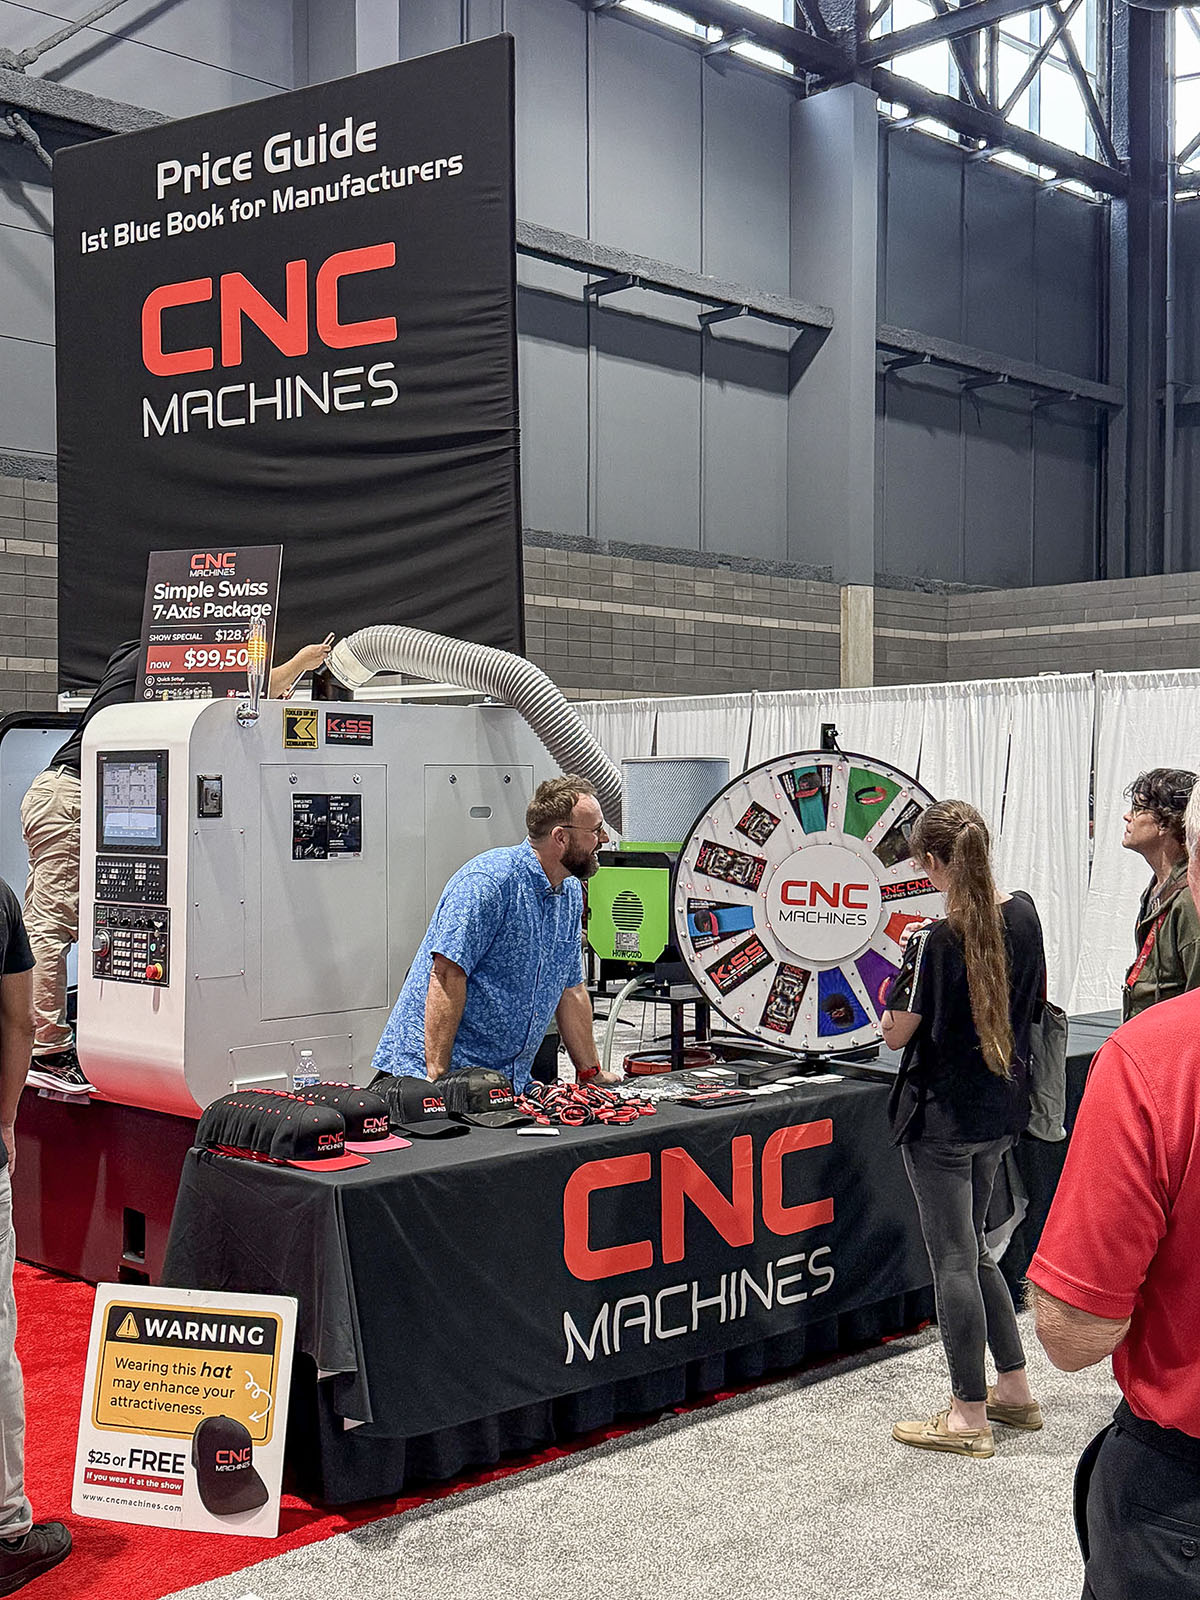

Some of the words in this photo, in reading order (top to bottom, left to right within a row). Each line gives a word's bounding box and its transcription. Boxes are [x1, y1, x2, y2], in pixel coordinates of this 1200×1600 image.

[156, 151, 253, 199] Price
[263, 116, 378, 174] Guide
[114, 216, 161, 247] Blue
[167, 202, 224, 238] Book
[229, 195, 266, 223] for
[272, 154, 464, 213] Manufacturers
[141, 241, 398, 377] CNC
[142, 361, 399, 438] MACHINES
[190, 552, 237, 569] CNC
[189, 568, 235, 577] MACHINES
[154, 581, 214, 602] Simple
[218, 578, 268, 597] Swiss
[152, 602, 201, 620] 7-Axis
[203, 601, 272, 618] Package
[150, 661, 171, 669] now
[184, 648, 249, 670] $99,50
[780, 880, 869, 909] CNC
[778, 910, 867, 926] MACHINES
[422, 1097, 445, 1107] CNC
[488, 1087, 511, 1098] CNC
[363, 1115, 388, 1128] CNC
[318, 1132, 343, 1145] CNC
[563, 1118, 834, 1281] CNC
[563, 1246, 835, 1364] MACHINES
[145, 1318, 264, 1346] WARNING
[115, 1357, 168, 1376] Wearing
[172, 1363, 197, 1376] this
[200, 1362, 233, 1379] hat
[112, 1378, 140, 1392] may
[143, 1380, 200, 1395] enhance
[202, 1387, 235, 1399] your
[110, 1396, 205, 1415] attractiveness.
[88, 1449, 111, 1464] $25
[113, 1456, 126, 1466] or
[128, 1448, 186, 1474] FREE
[216, 1447, 250, 1464] CNC
[86, 1471, 93, 1479] If
[94, 1474, 108, 1482] you
[109, 1476, 127, 1484] wear
[128, 1477, 135, 1485] it
[136, 1478, 145, 1486] at
[146, 1479, 159, 1488] the
[161, 1481, 182, 1490] show
[82, 1493, 182, 1512] www.cncmachines.com
